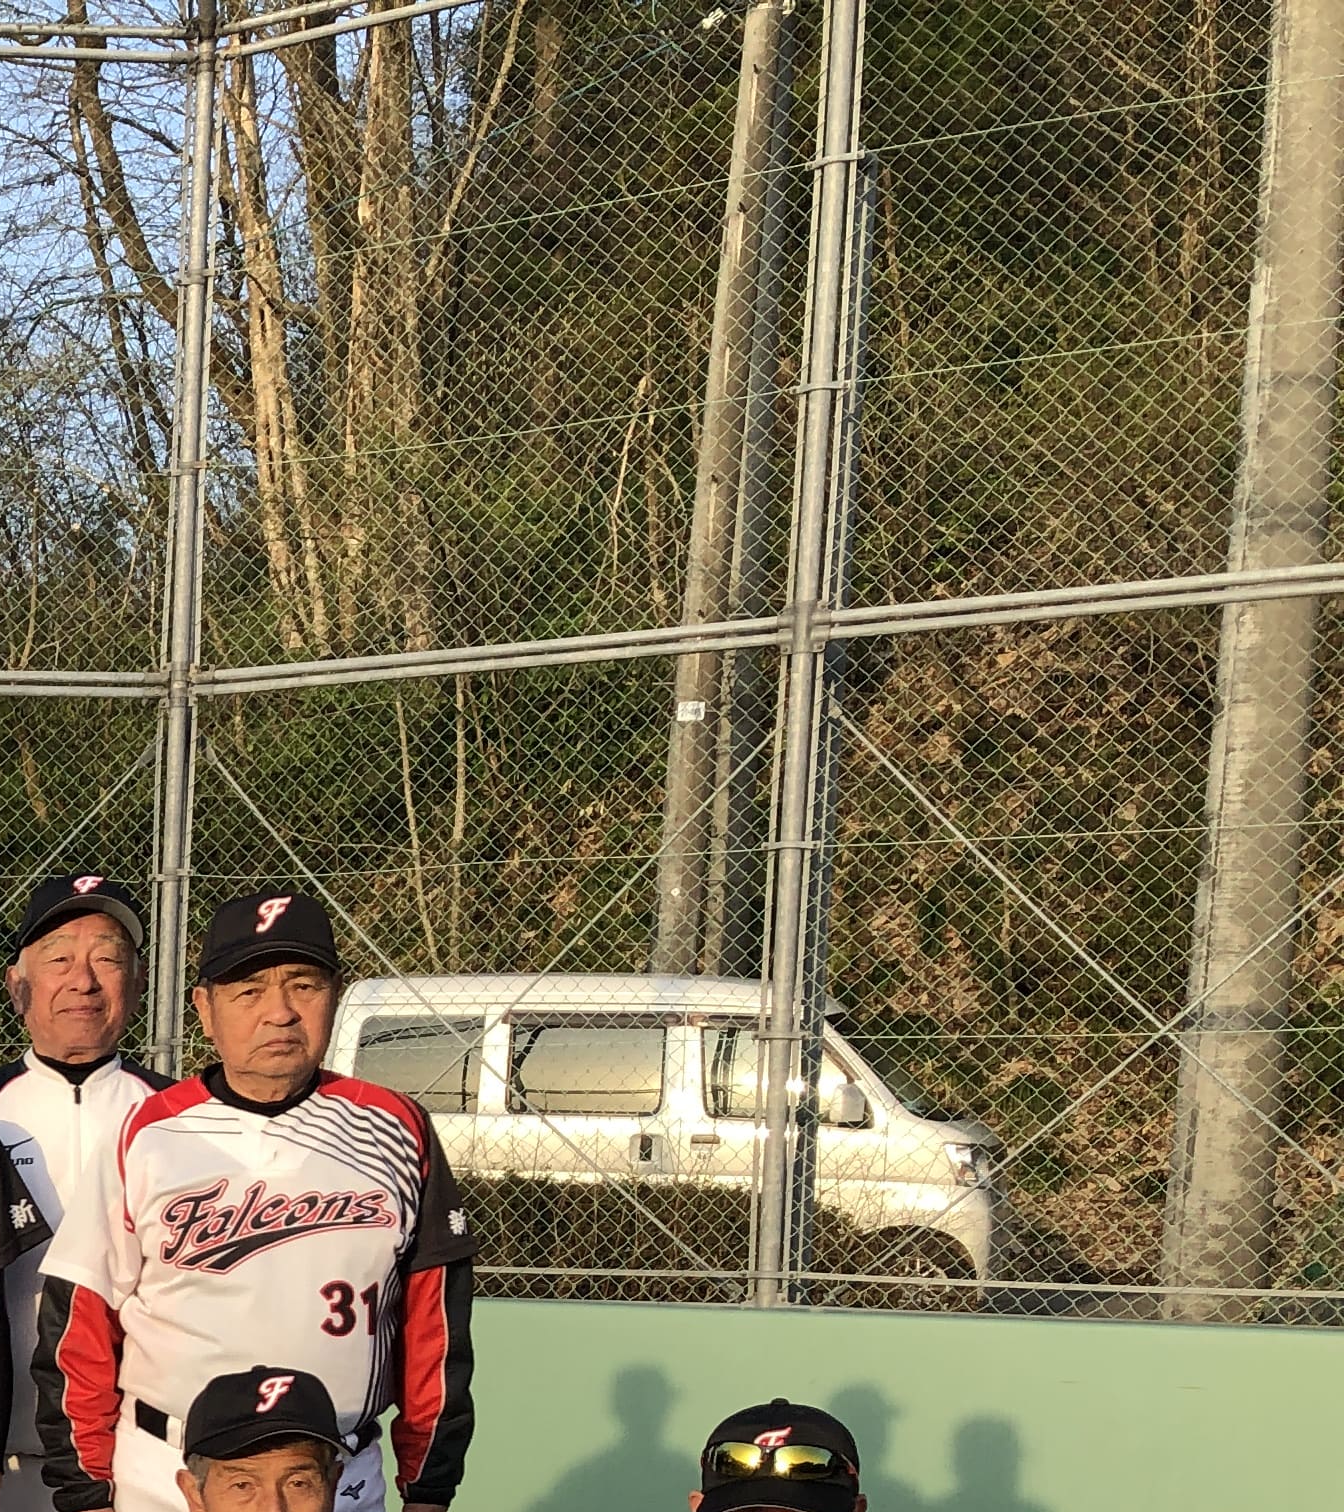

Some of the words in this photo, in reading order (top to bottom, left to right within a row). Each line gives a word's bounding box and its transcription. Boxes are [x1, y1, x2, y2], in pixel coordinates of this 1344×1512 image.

[72, 875, 104, 894] F
[255, 895, 292, 933] F
[9, 1198, 36, 1229] 新
[160, 1178, 396, 1273] Falcons
[319, 1279, 379, 1337] 31
[255, 1375, 294, 1413] F
